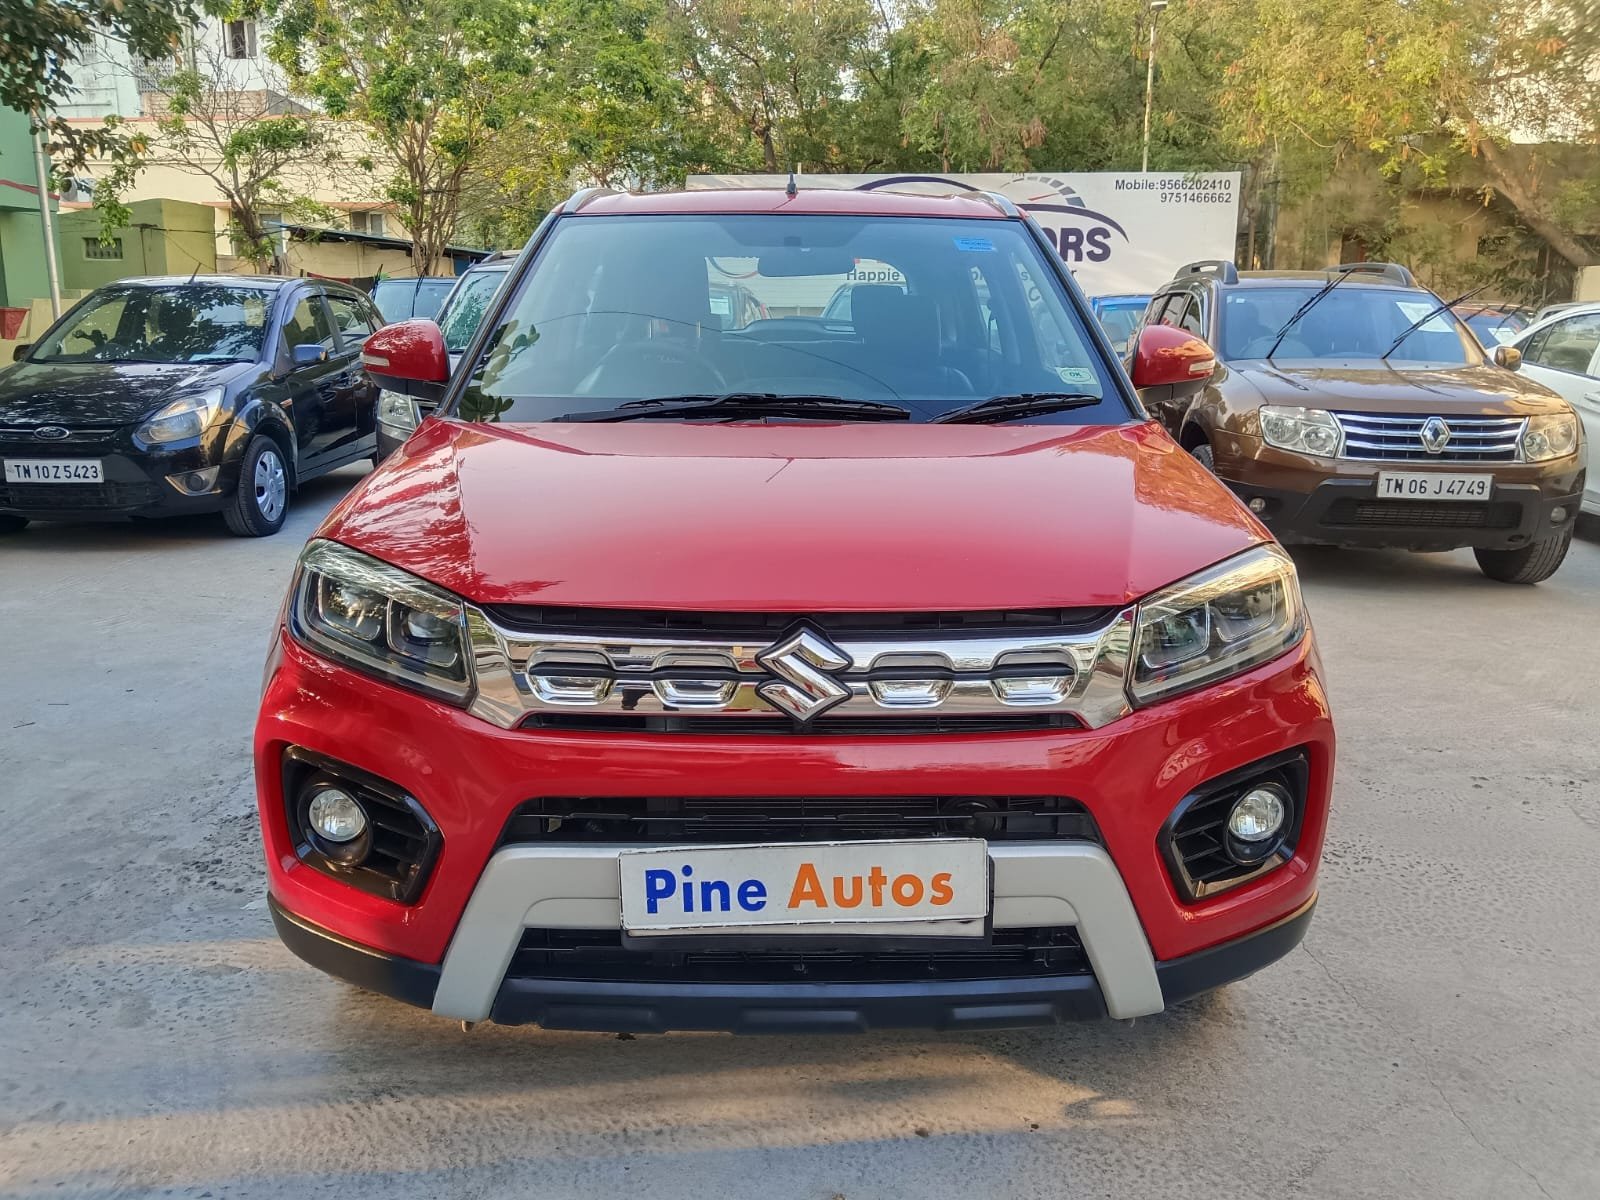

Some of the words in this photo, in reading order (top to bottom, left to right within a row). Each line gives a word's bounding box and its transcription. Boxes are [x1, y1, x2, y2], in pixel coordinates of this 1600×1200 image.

[1160, 192, 1232, 204] 9751466662
[645, 865, 768, 914] Pine
[787, 863, 954, 909] Autos
